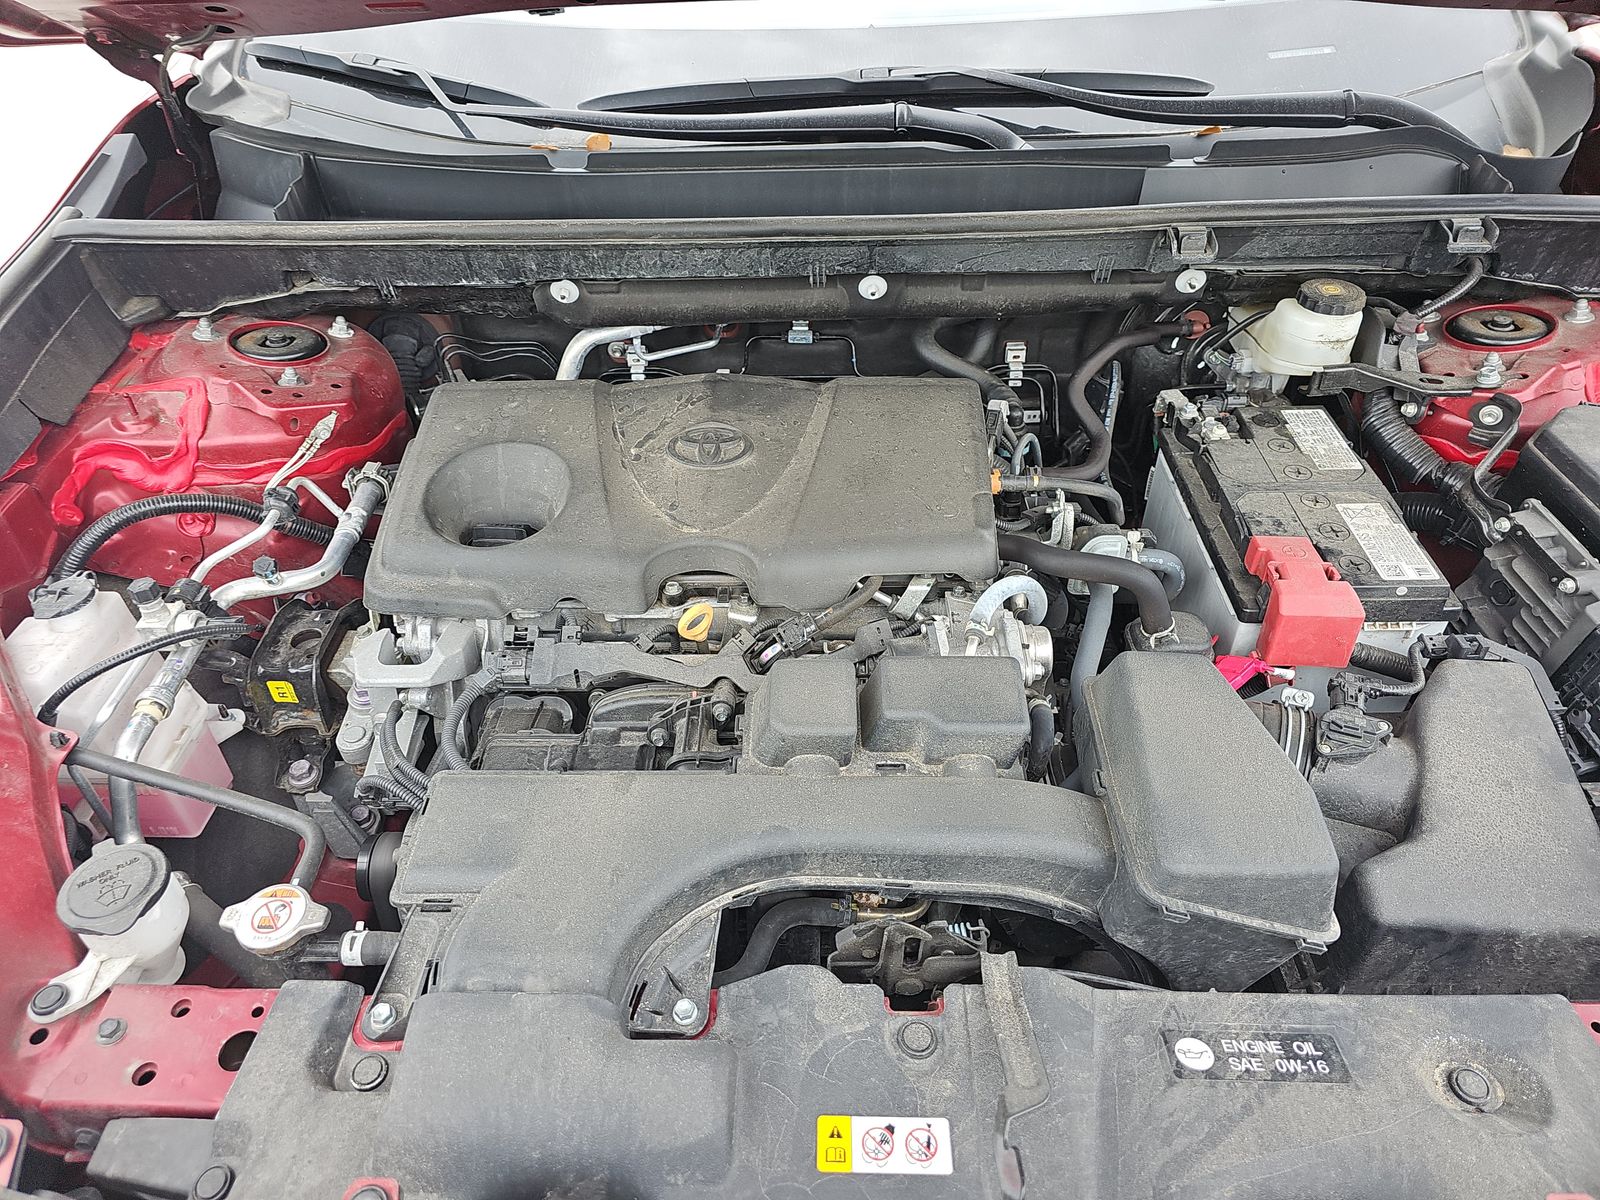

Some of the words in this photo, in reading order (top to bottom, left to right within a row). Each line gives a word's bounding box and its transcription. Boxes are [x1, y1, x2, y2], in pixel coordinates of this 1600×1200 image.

[1220, 1039, 1285, 1054] ENGINE
[1292, 1041, 1324, 1056] OIL
[1228, 1057, 1266, 1072] SAE
[1275, 1059, 1330, 1074] 0W-16
